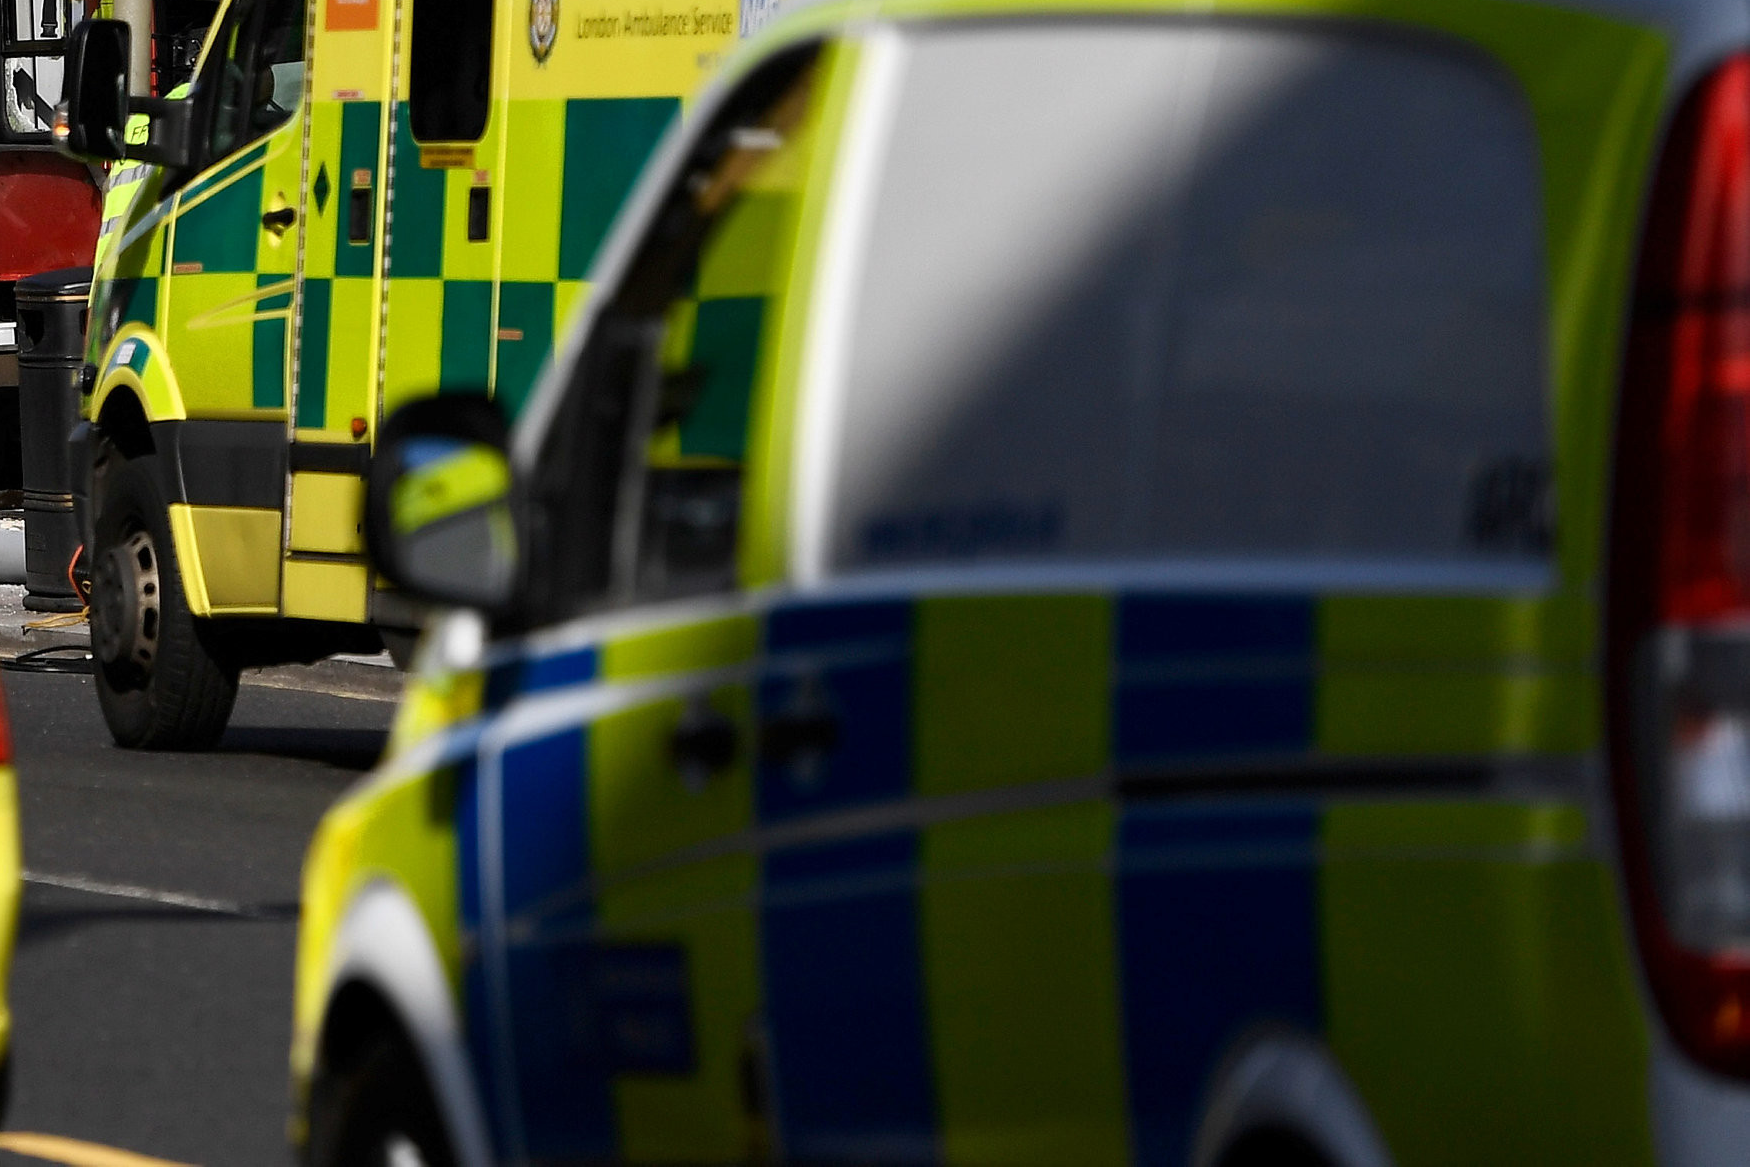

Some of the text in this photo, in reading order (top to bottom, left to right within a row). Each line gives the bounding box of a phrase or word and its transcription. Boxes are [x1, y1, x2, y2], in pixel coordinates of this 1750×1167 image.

[576, 6, 733, 39] London Ambulance Service
